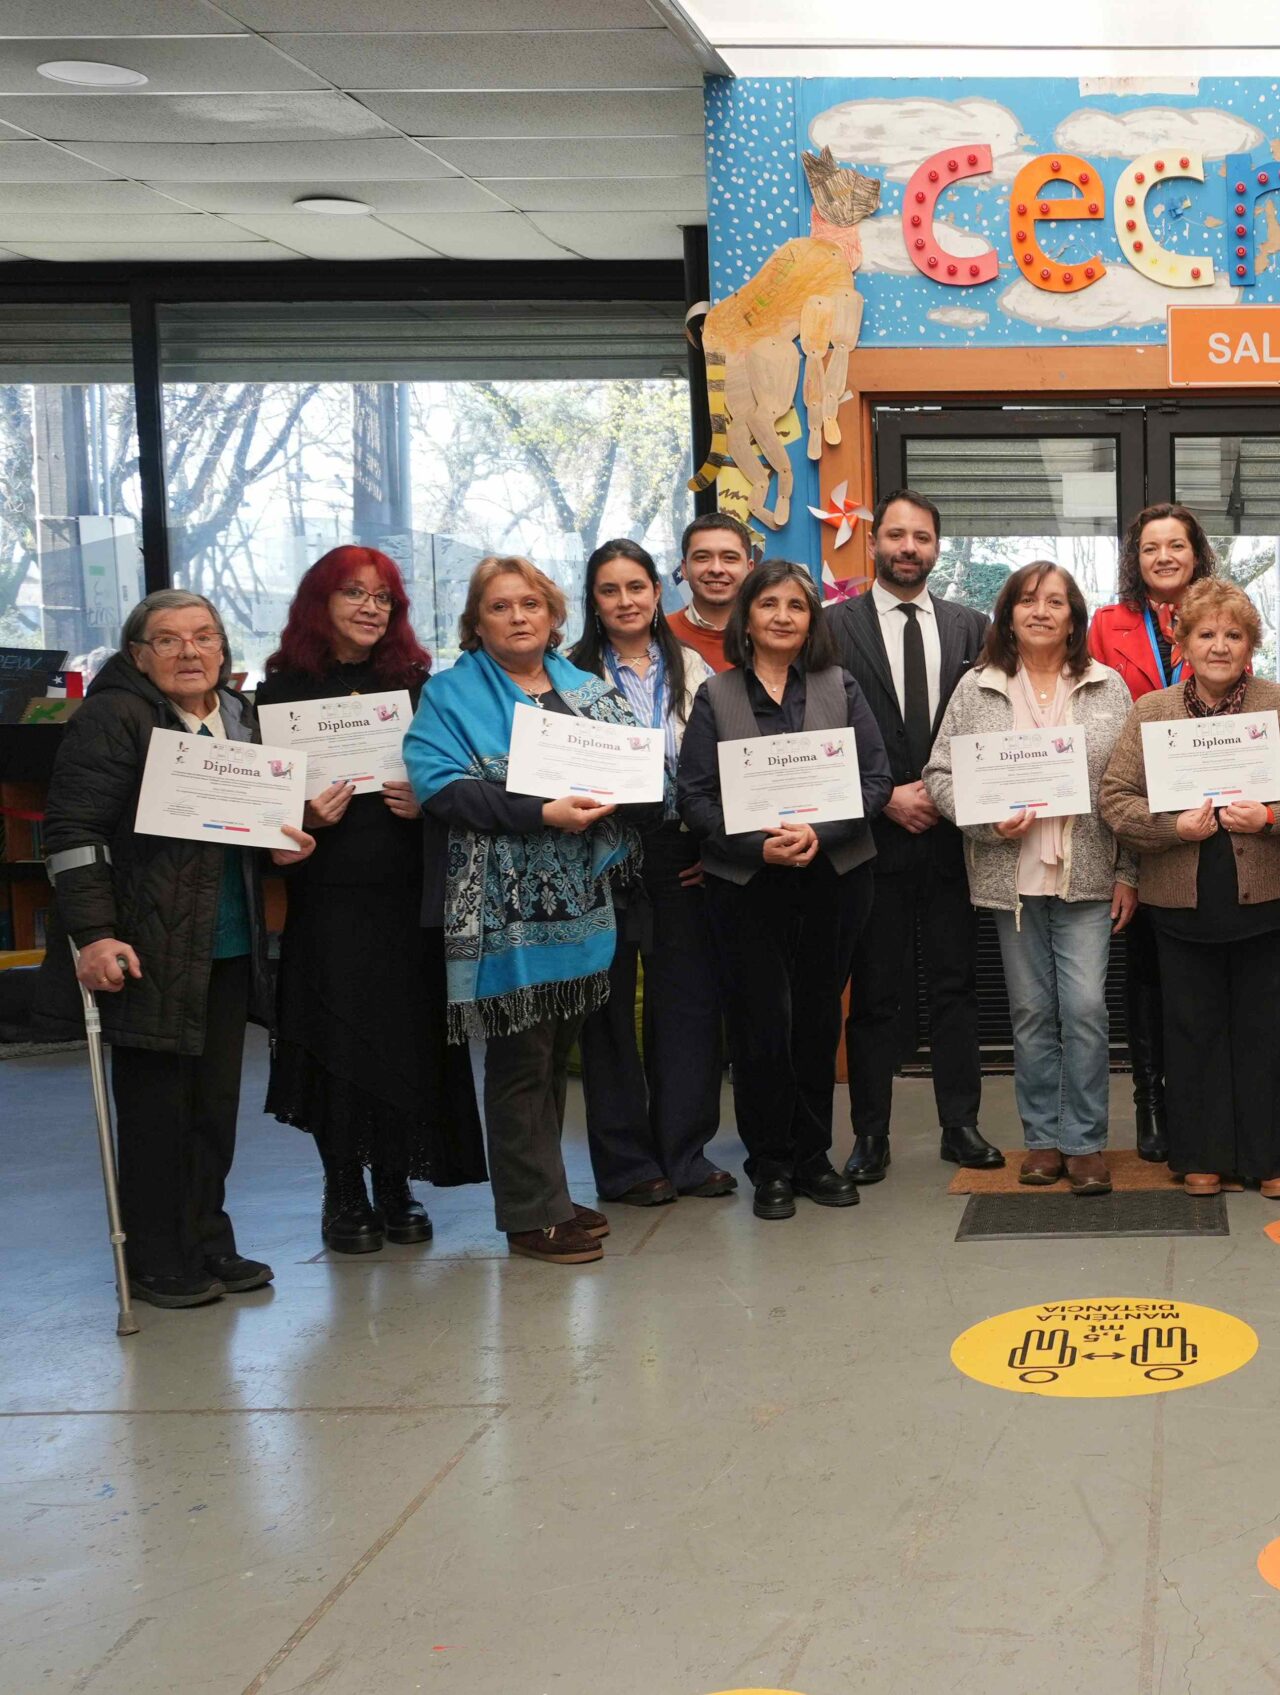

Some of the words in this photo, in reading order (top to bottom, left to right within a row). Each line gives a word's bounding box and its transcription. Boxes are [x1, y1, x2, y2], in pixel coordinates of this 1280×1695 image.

[318, 720, 371, 732] Diploma
[568, 735, 621, 751] Diploma
[1193, 737, 1242, 749] Diploma
[768, 754, 817, 767] Diploma
[1000, 750, 1048, 762] Diploma
[203, 759, 261, 777] Diploma
[1043, 1304, 1175, 1313] DISTANCIA
[1083, 1332, 1127, 1343] 1,5
